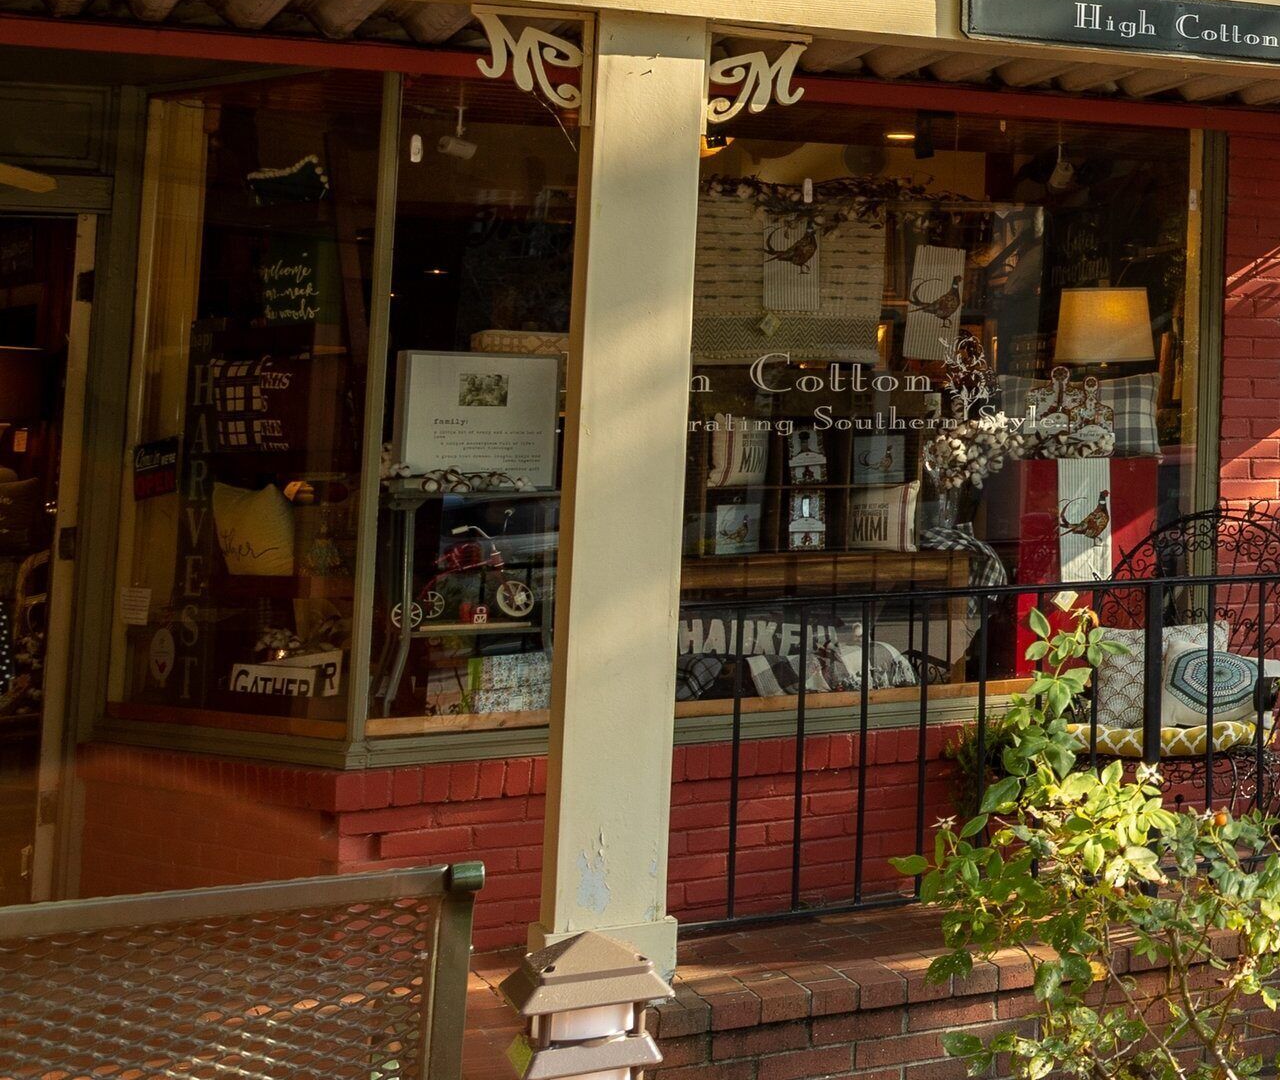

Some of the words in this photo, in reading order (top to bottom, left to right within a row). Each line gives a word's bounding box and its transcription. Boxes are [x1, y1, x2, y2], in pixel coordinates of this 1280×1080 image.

[1074, 2, 1157, 38] High
[1175, 14, 1280, 47] Cotton
[750, 352, 934, 392] Cotton
[813, 406, 958, 431] Southern
[852, 516, 888, 541] MIMI
[233, 669, 310, 696] GATHER
